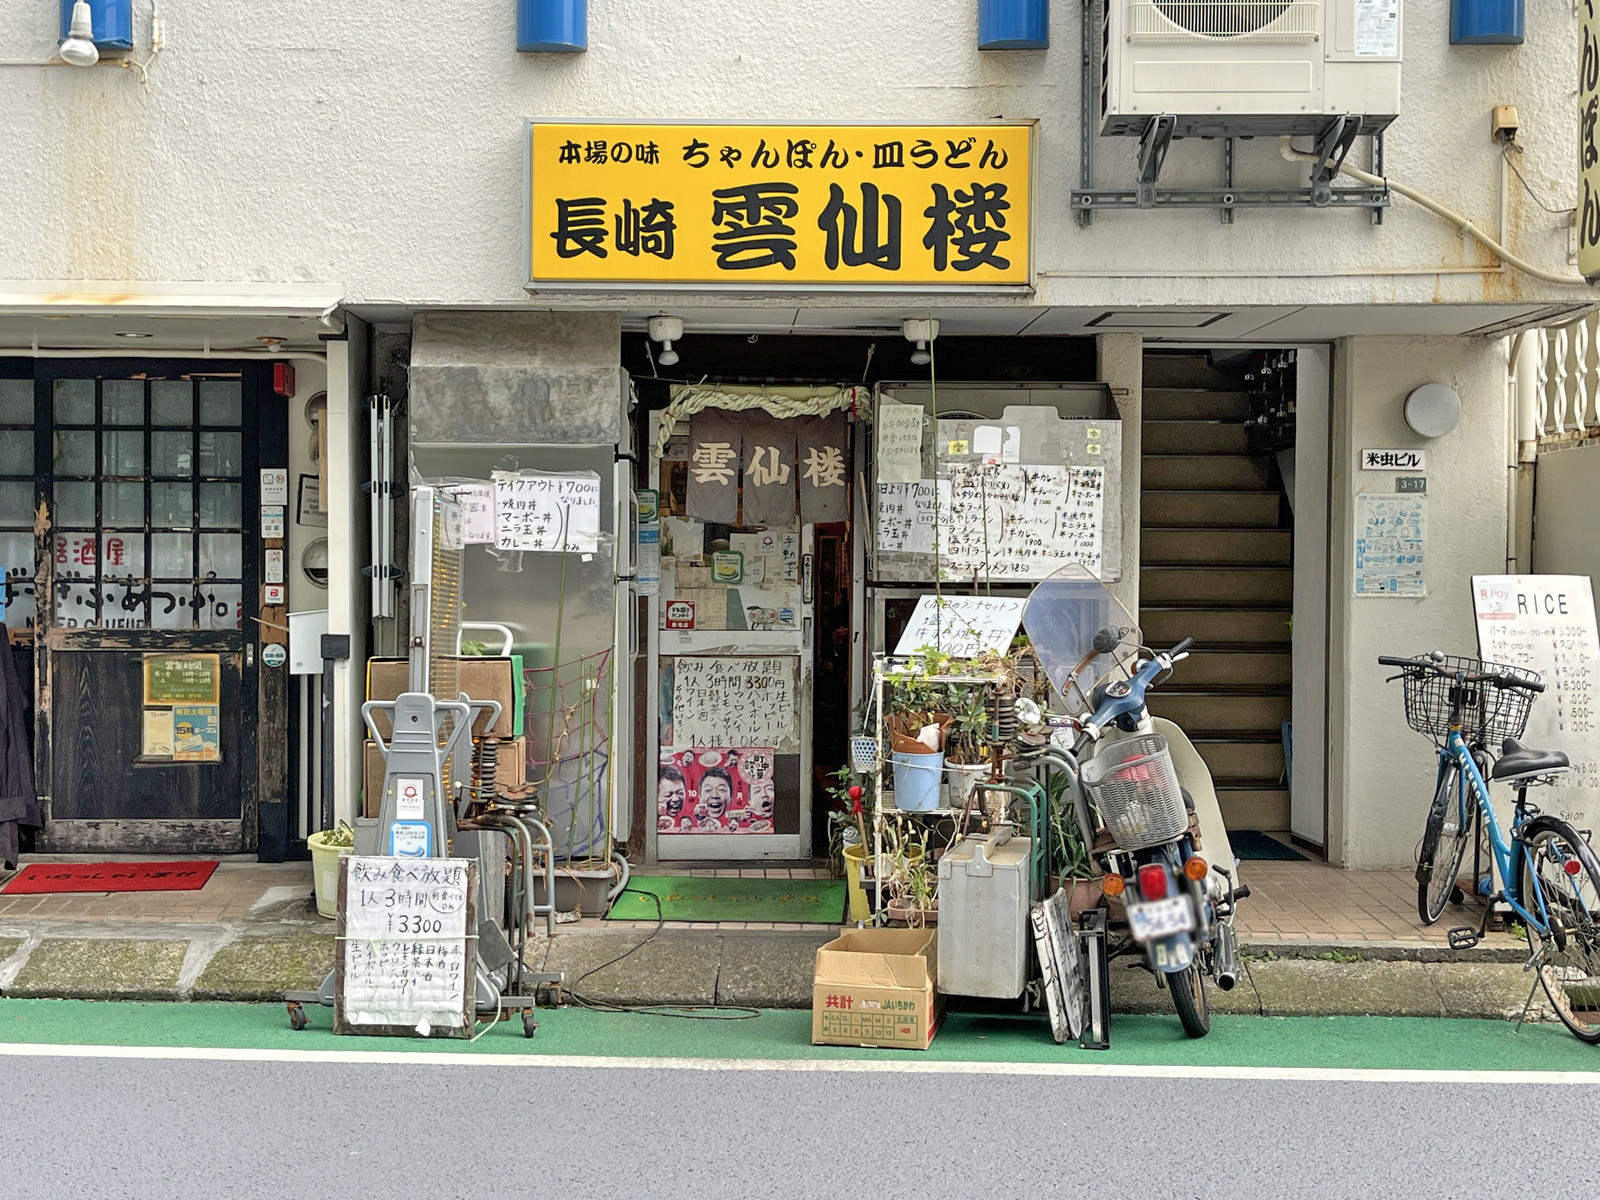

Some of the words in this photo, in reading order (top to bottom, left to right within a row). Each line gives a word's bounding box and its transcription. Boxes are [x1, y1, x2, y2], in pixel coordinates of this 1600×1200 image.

[1580, 0, 1600, 249] んぽん
[559, 140, 660, 165] 本場の味
[682, 137, 1009, 169] ちゃんぽん・皿うどん
[550, 197, 677, 260] 長崎
[711, 182, 1012, 271] 雲仙楼
[691, 442, 846, 488] 雲仙楼
[1366, 452, 1421, 467] 米虫ビル
[1401, 480, 1425, 489] 3-17
[826, 994, 854, 1009] 共計
